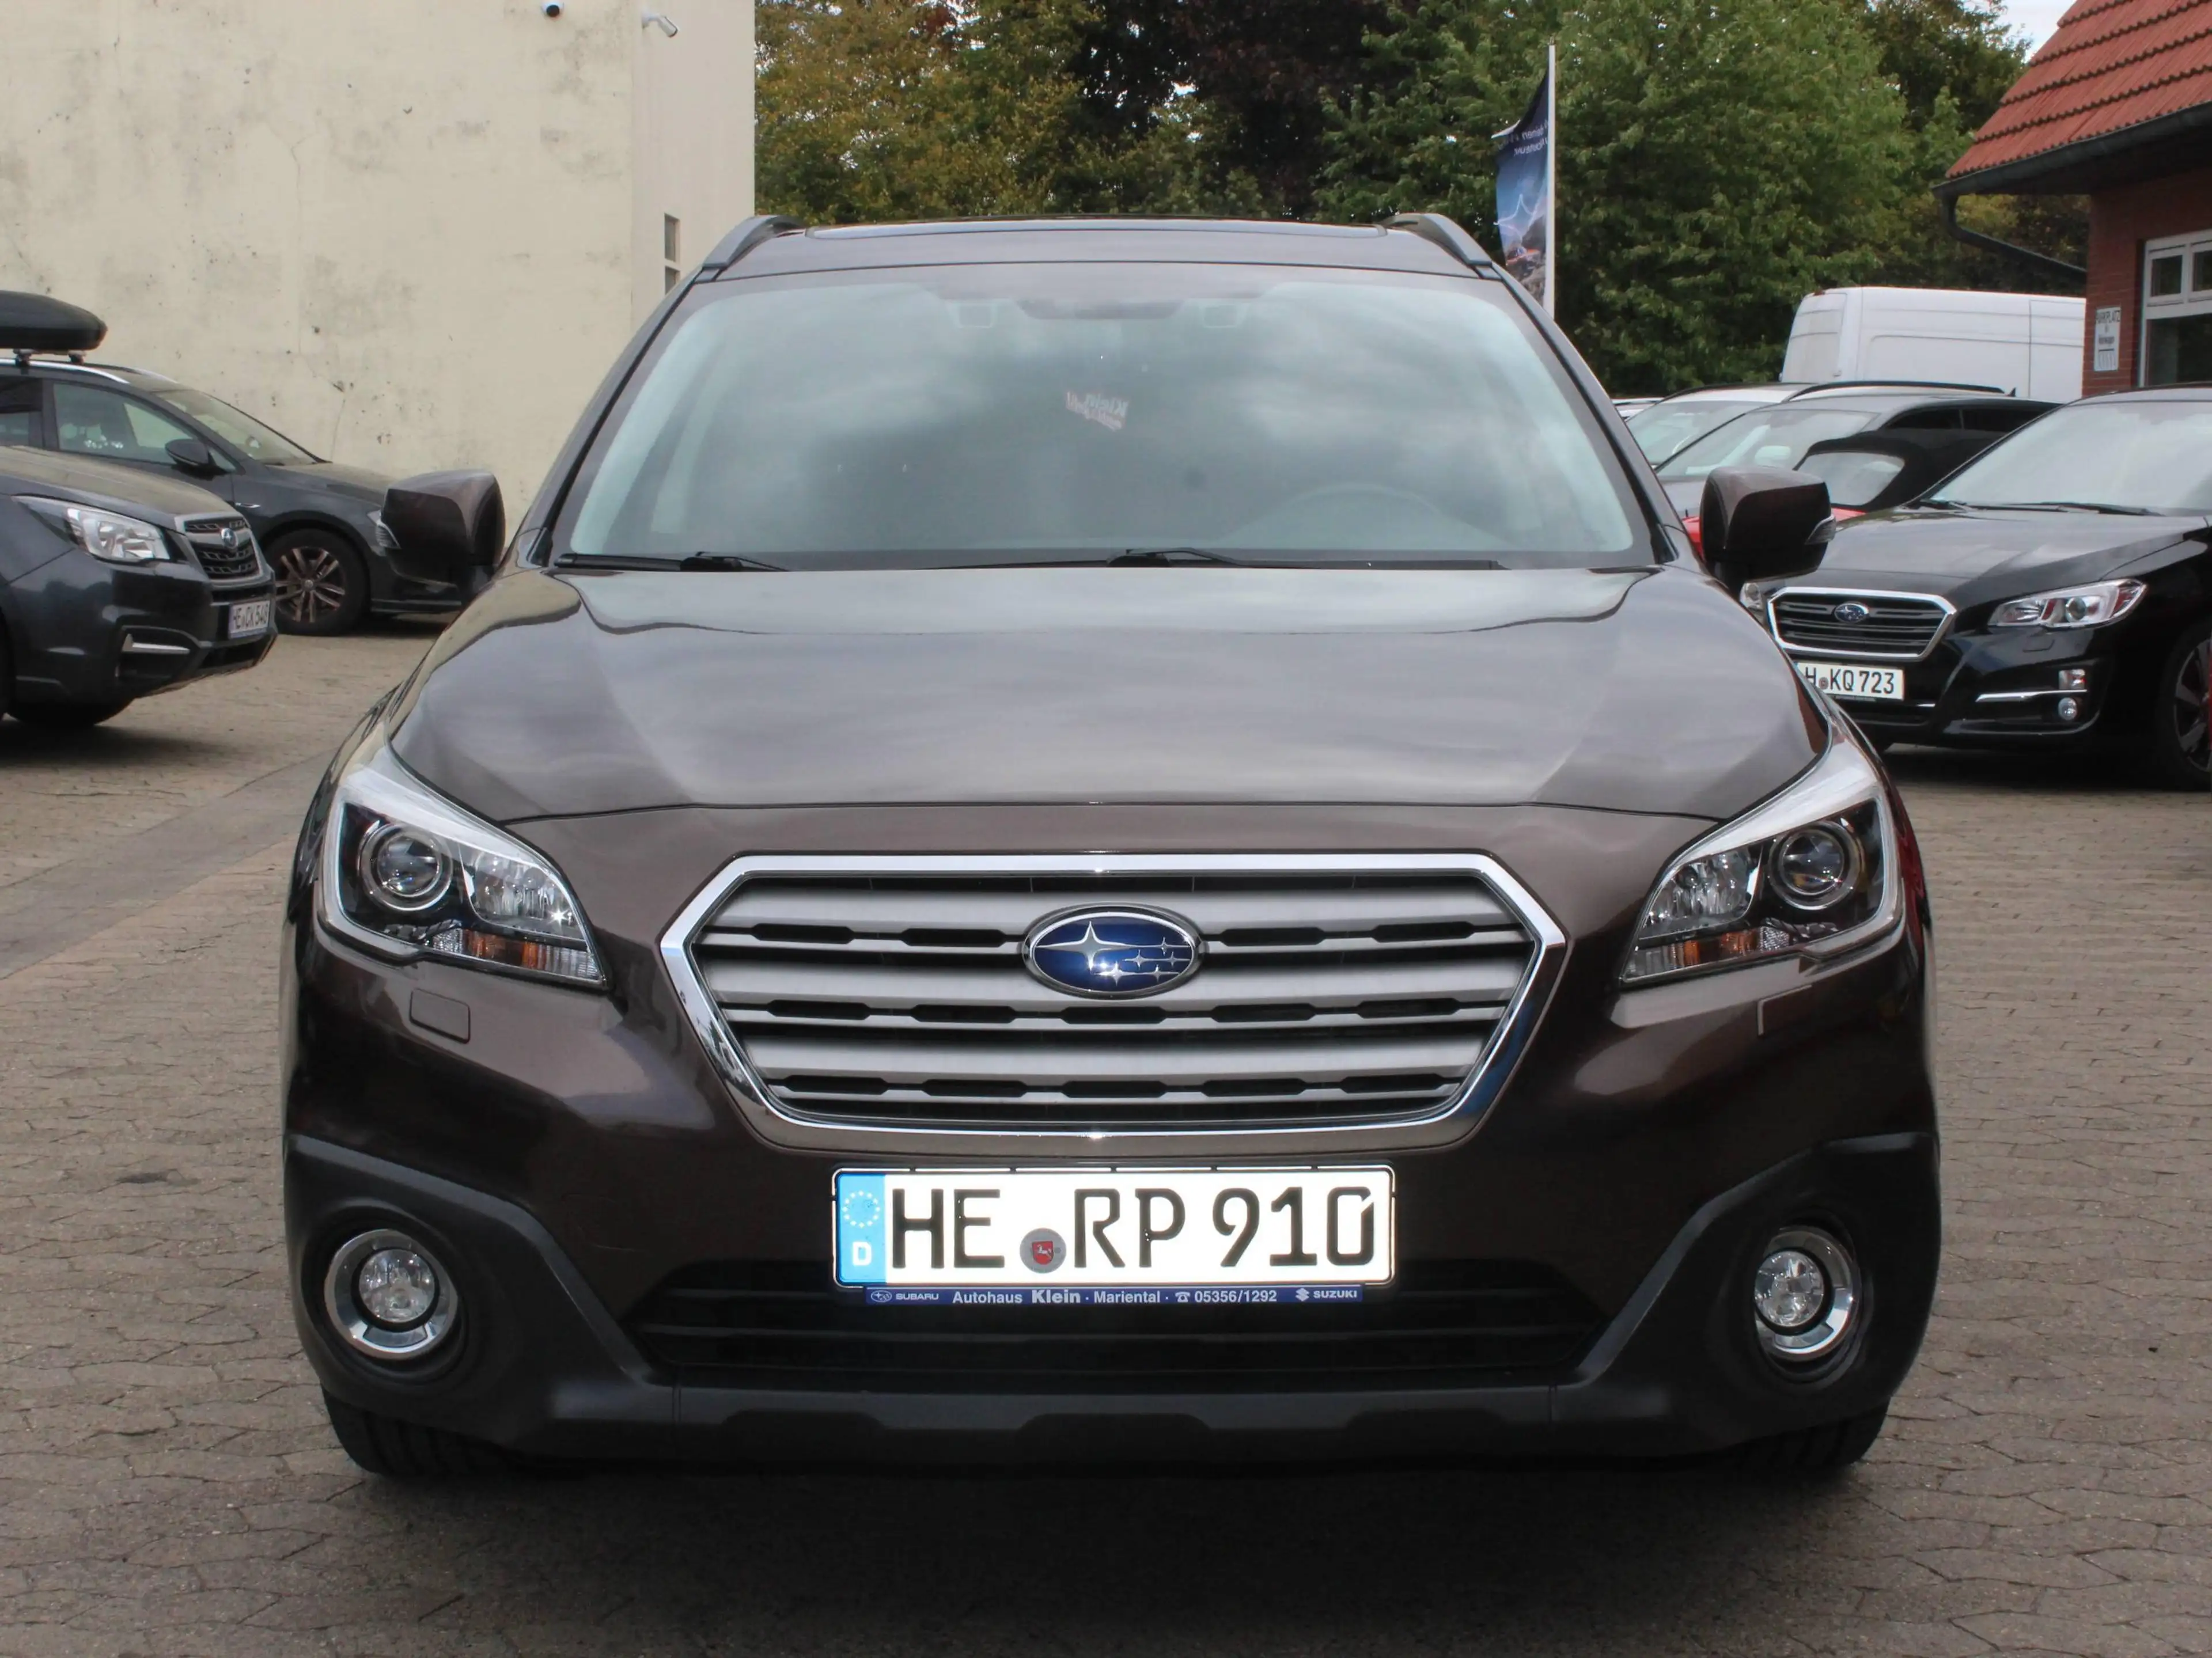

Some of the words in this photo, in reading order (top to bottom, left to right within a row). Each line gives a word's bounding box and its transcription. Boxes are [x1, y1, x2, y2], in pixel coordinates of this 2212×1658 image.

[1805, 667, 1816, 686] H
[1830, 669, 1854, 691] KQ
[1859, 670, 1894, 694] 723
[892, 1188, 1005, 1269] HE
[1074, 1187, 1185, 1269] RP
[1213, 1186, 1375, 1268] 910
[853, 1242, 872, 1265] D
[896, 1292, 939, 1300] SUBARU
[952, 1291, 1023, 1304] Autohaus
[1032, 1289, 1081, 1303] Klein
[1094, 1291, 1160, 1304] Mariental
[1195, 1289, 1277, 1303] 05356/1292
[1313, 1290, 1357, 1299] SUZUKI
